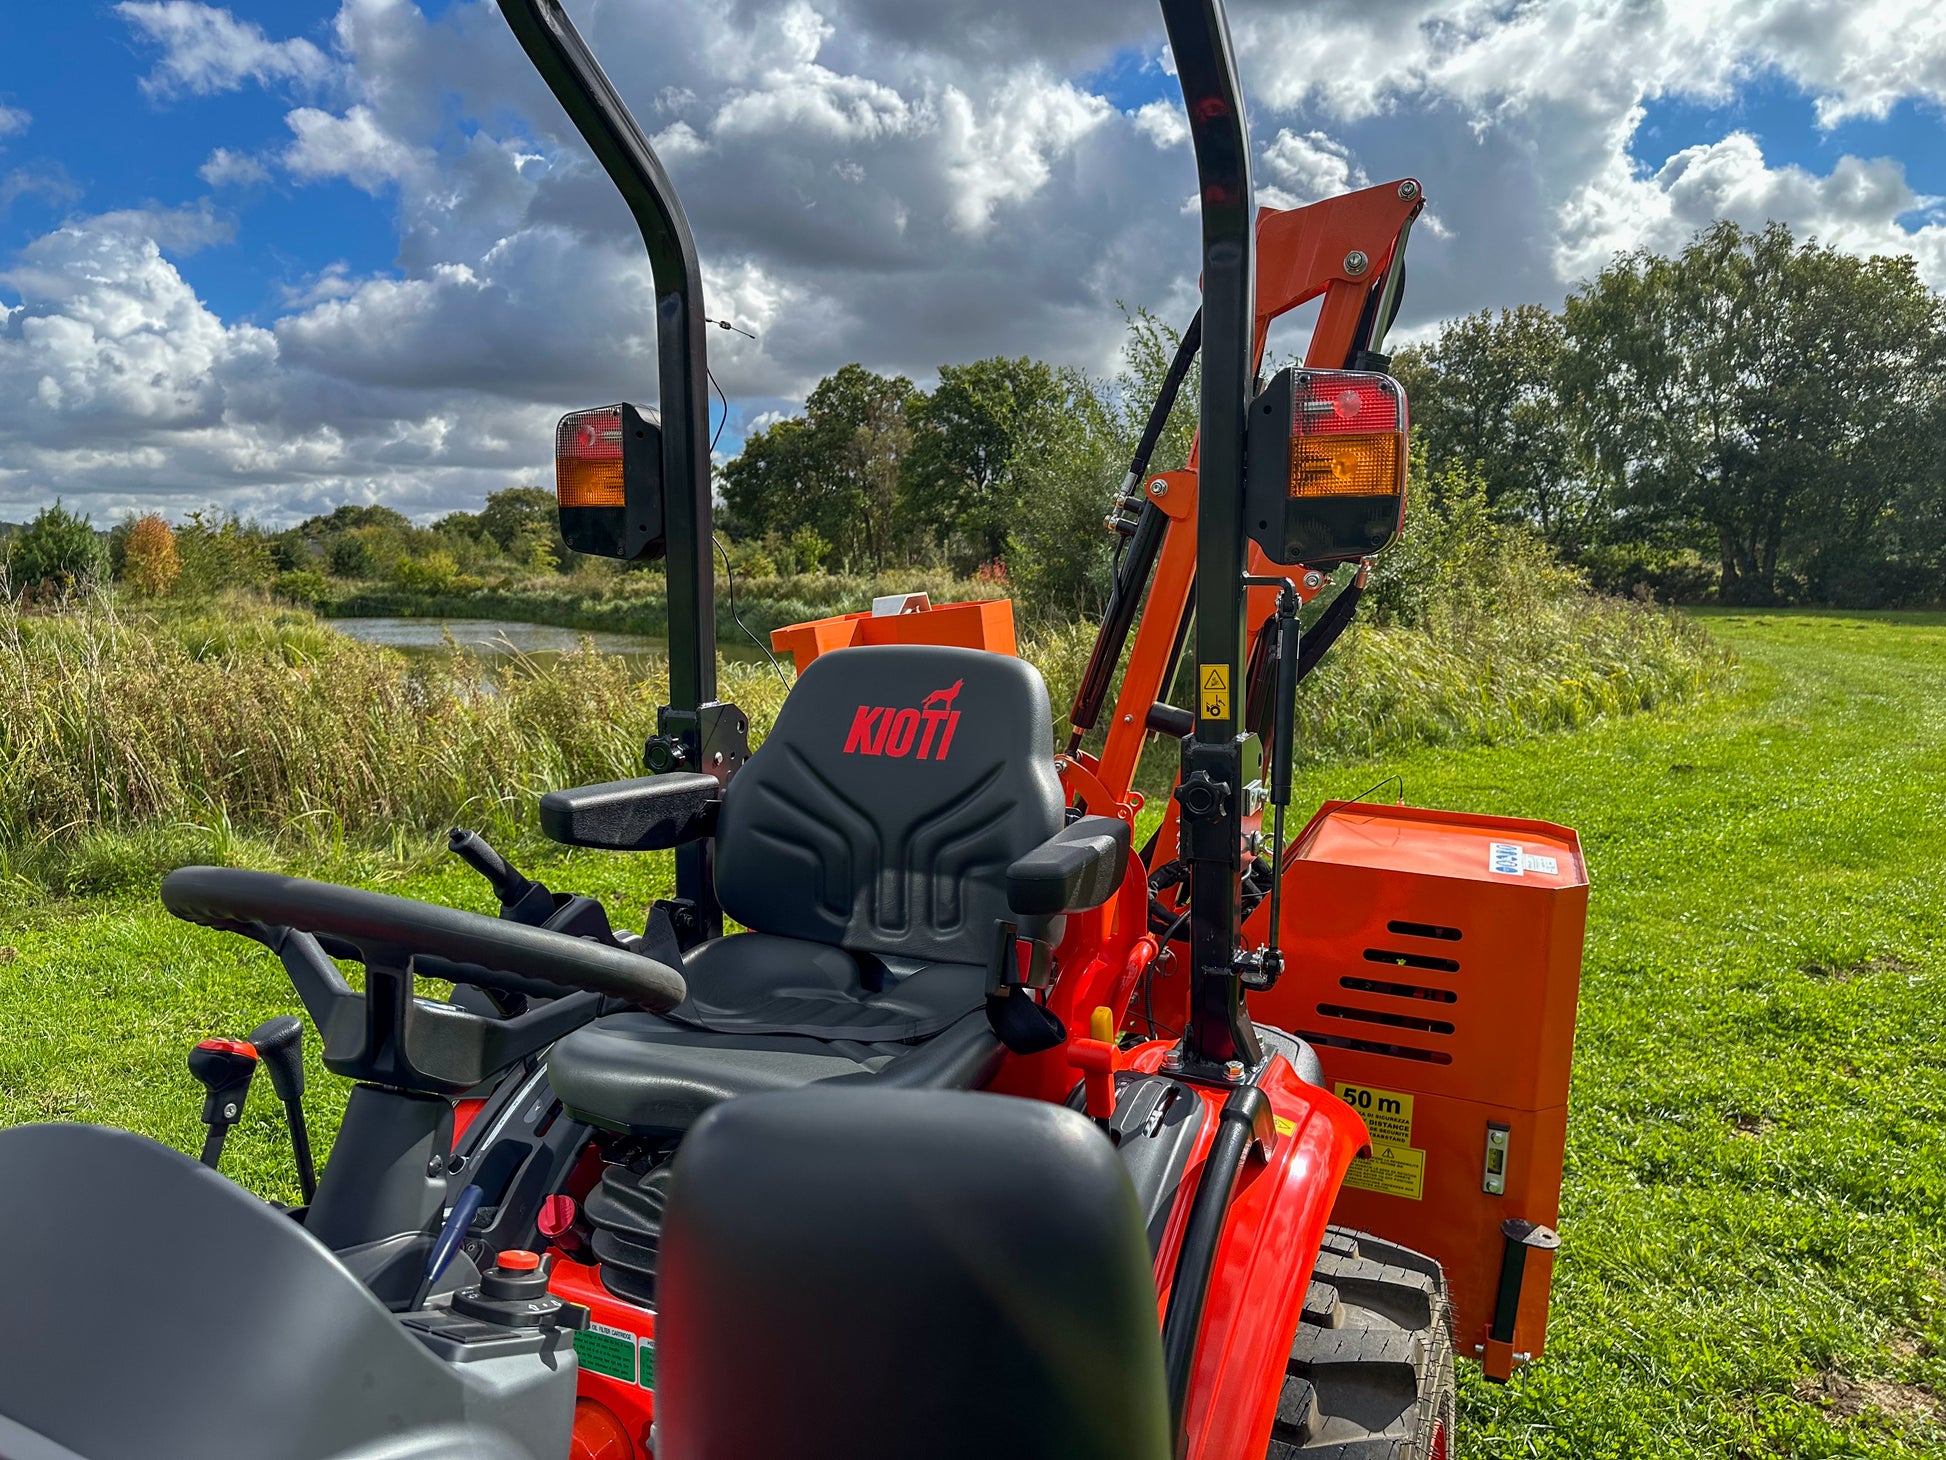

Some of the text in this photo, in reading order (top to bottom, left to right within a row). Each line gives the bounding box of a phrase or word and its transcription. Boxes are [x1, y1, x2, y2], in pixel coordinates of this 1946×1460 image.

[843, 705, 962, 761] KIOTI
[1343, 1087, 1401, 1115] 50 m
[1369, 1119, 1409, 1132] DISTANCE
[1375, 1114, 1410, 1125] SICUREZZA
